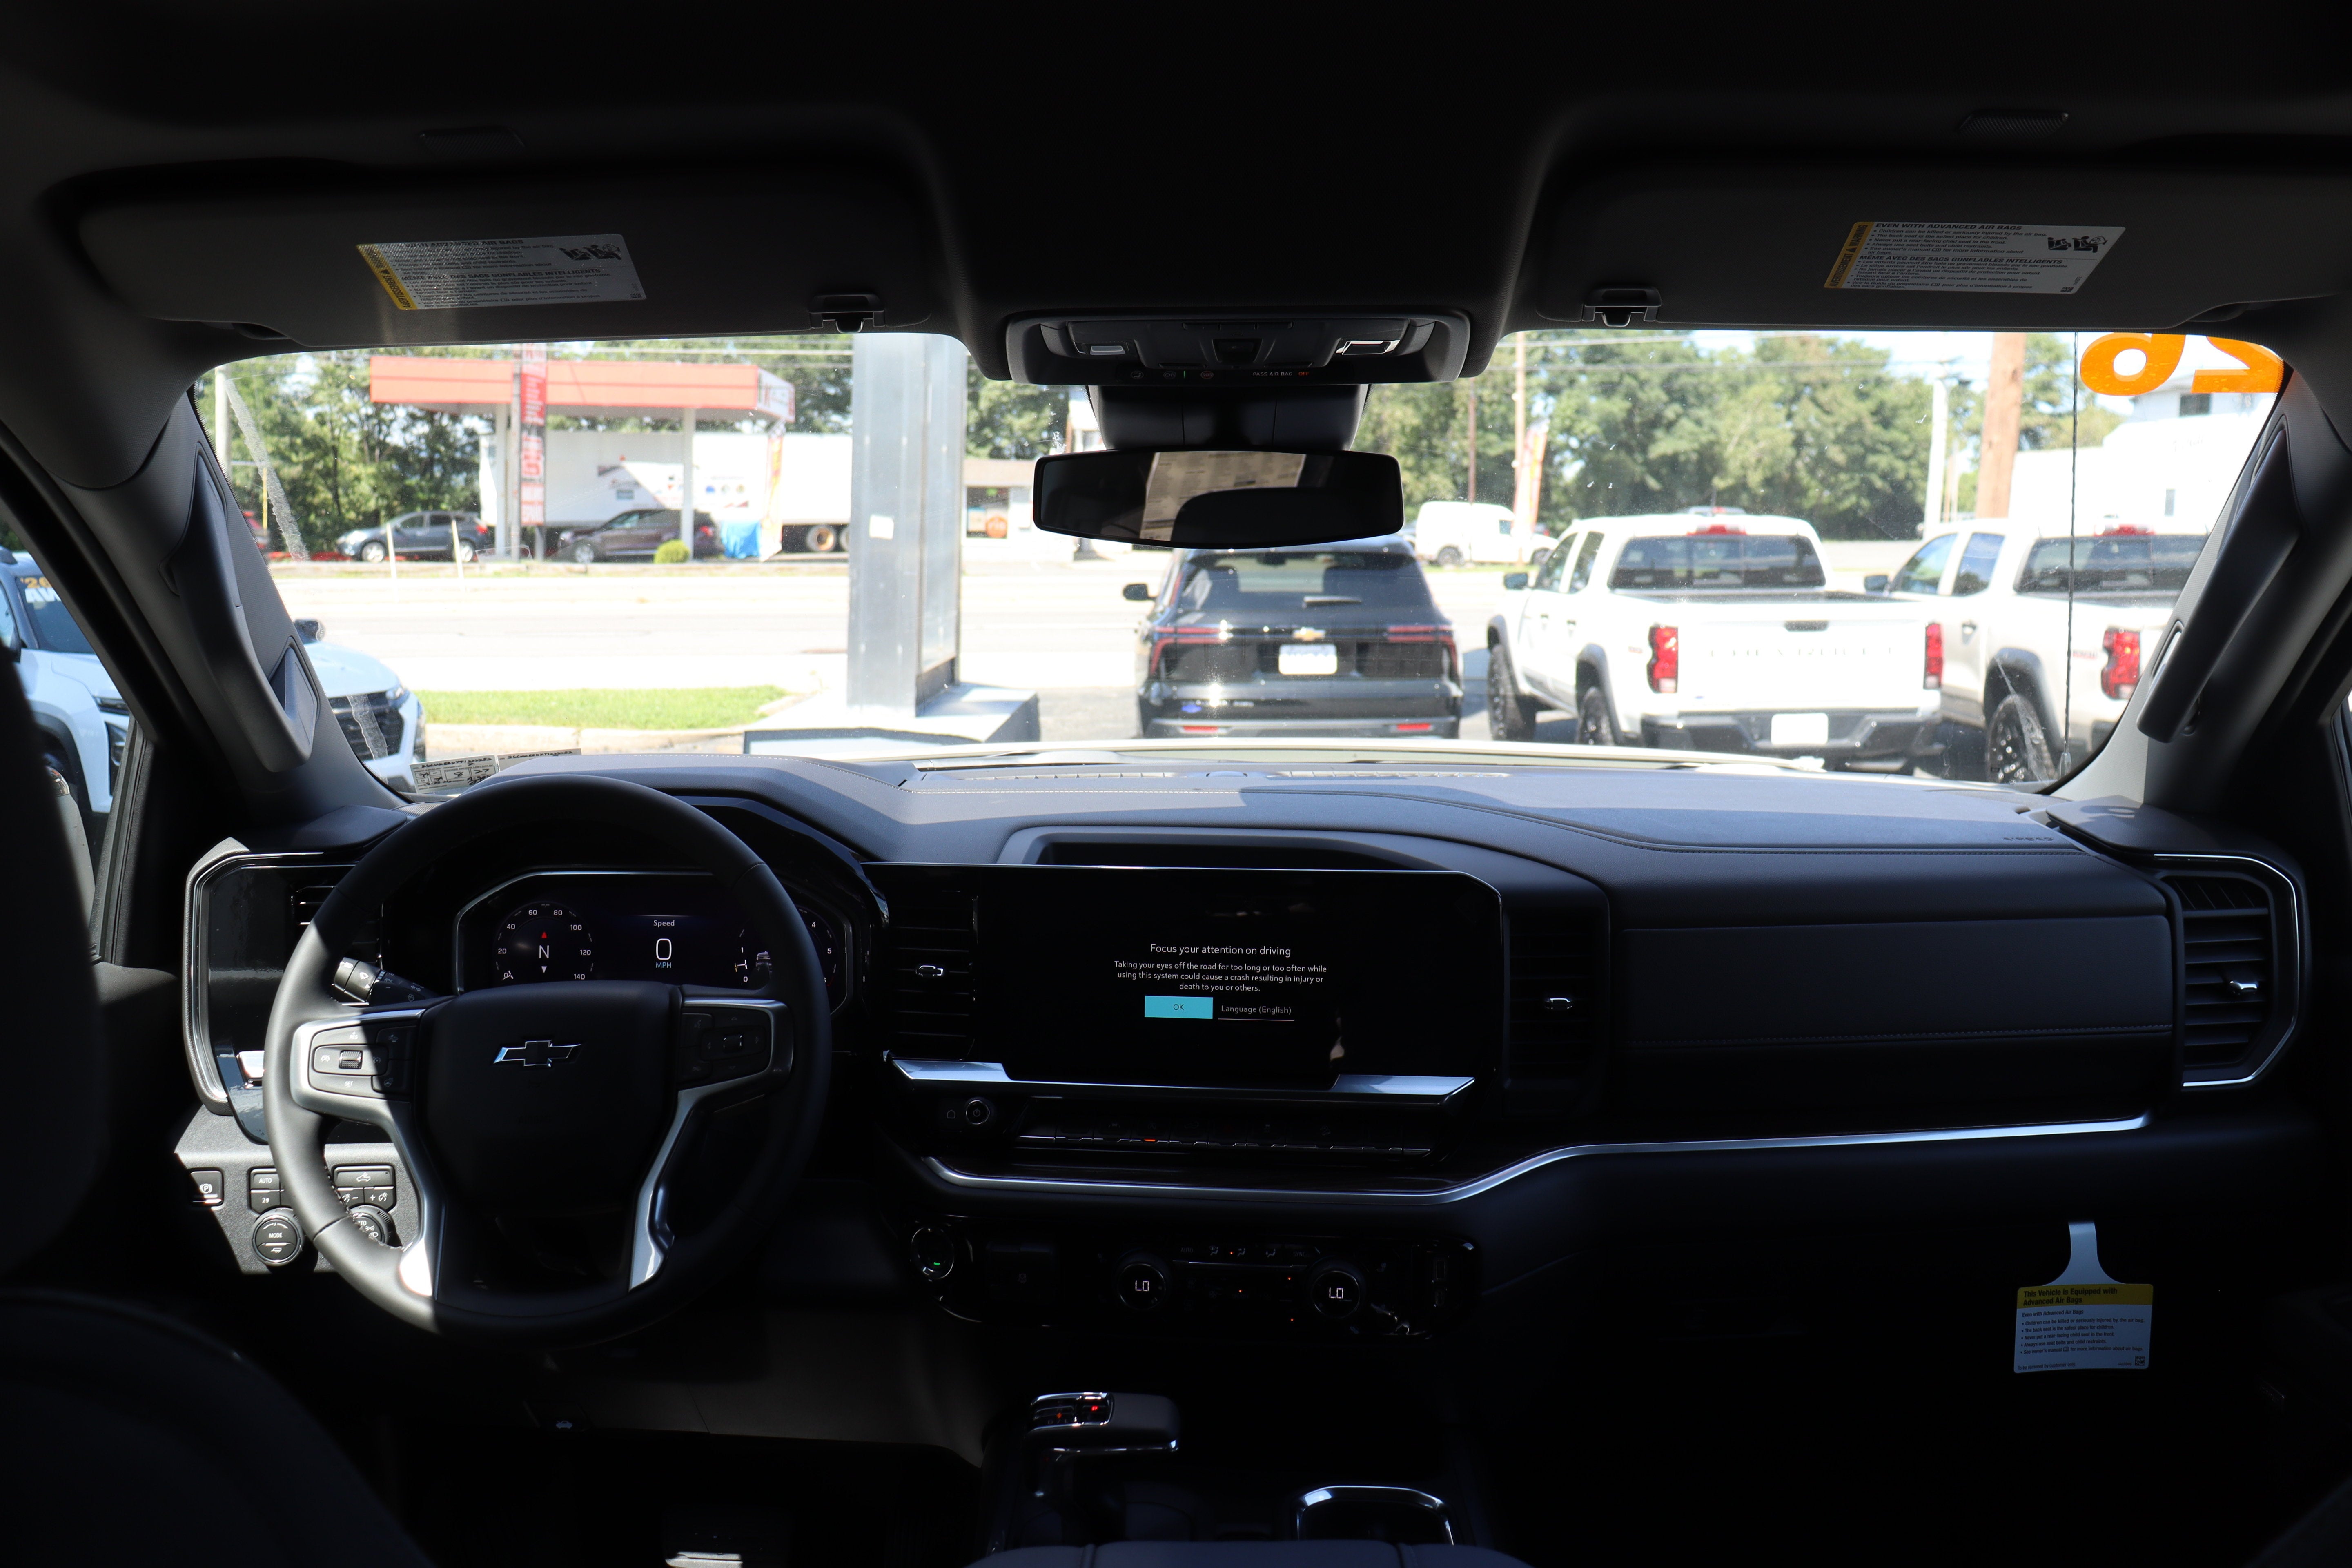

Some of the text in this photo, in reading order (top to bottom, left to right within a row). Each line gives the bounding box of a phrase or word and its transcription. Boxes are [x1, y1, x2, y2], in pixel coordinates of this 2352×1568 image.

[1850, 224, 1868, 246] WARNING
[1829, 253, 1851, 287] AVERTISSEMENT
[25, 588, 61, 603] AW
[539, 945, 549, 958] N
[656, 938, 672, 960] 0
[1151, 944, 1176, 952] Focus
[1179, 947, 1199, 955] your
[1259, 947, 1290, 957] driving
[1114, 960, 1137, 969] Taking
[1245, 964, 1260, 972] long
[1118, 971, 1136, 980] using
[1252, 975, 1283, 983] resulting
[1294, 976, 1314, 984] injury
[1259, 1006, 1291, 1014] (English)
[1135, 1281, 1149, 1292] LO
[1329, 1287, 1343, 1300] LO
